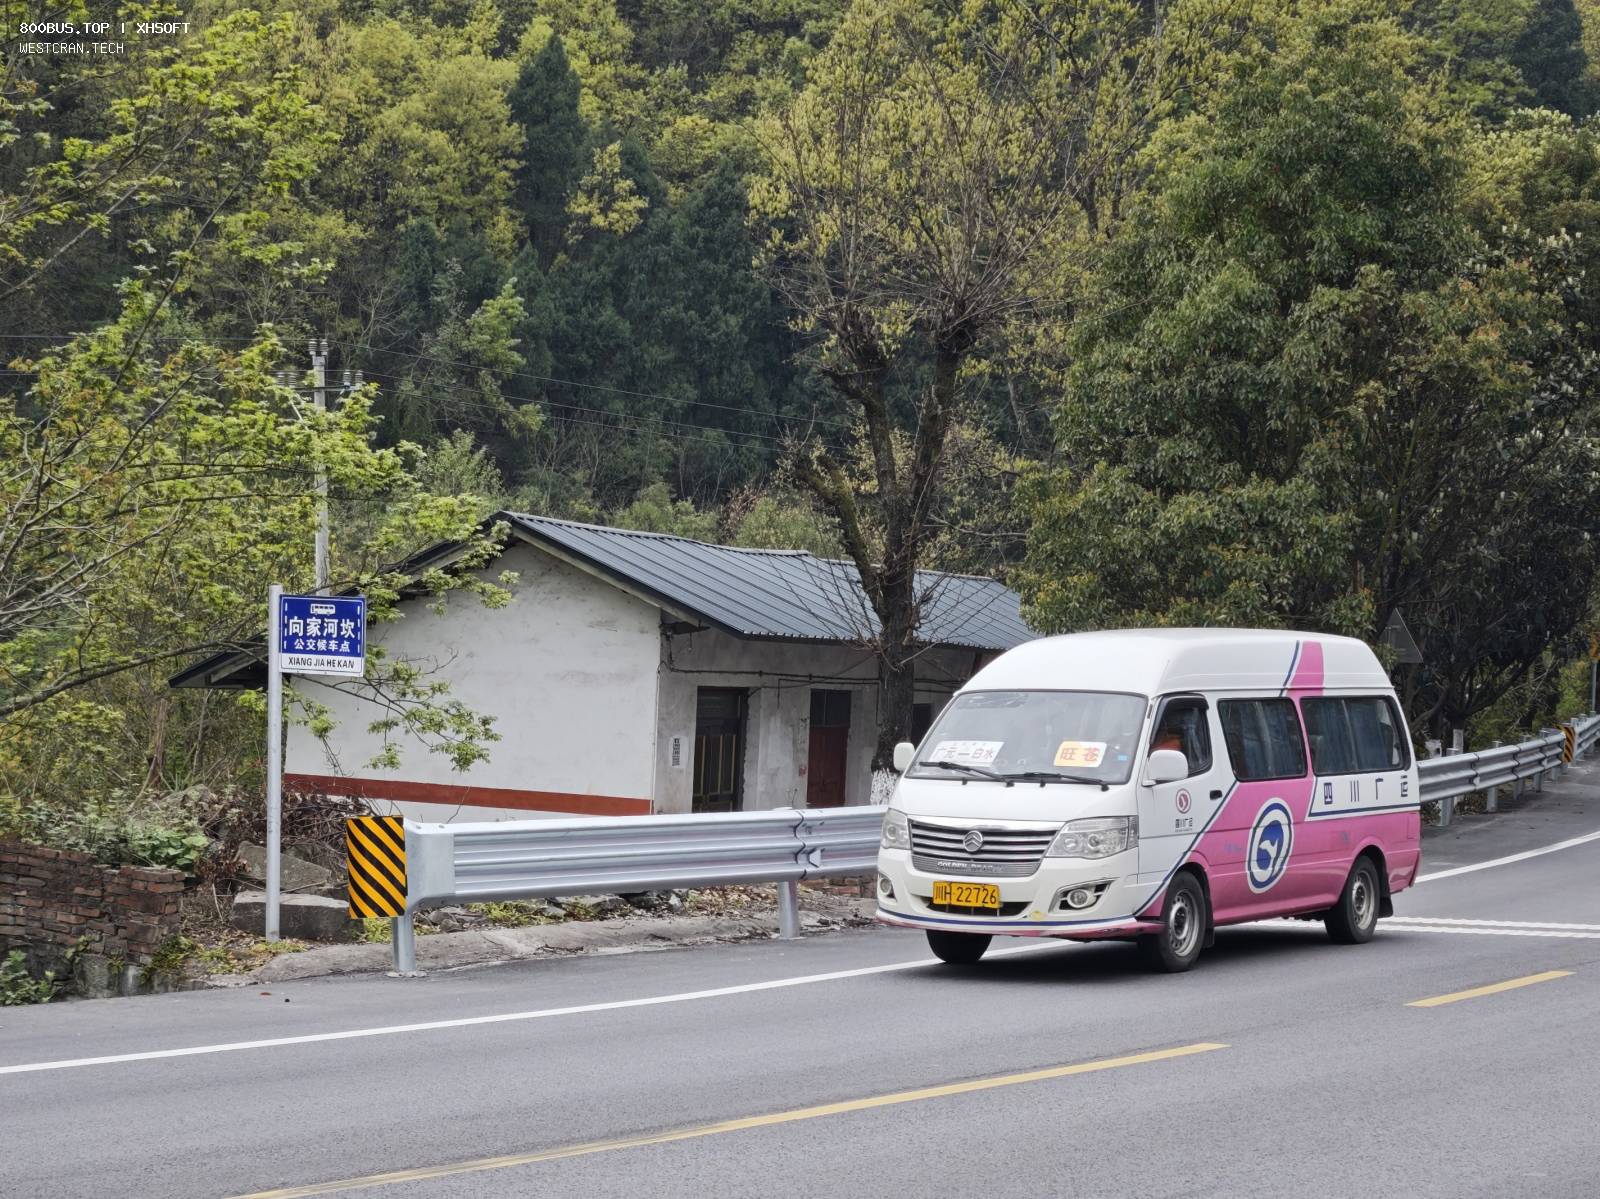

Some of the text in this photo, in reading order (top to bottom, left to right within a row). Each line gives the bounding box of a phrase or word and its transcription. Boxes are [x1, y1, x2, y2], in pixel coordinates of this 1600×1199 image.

[288, 616, 356, 638] 向家河坎
[294, 638, 351, 653] 公交候车点
[288, 656, 355, 669] XIANG JIA HE KAN
